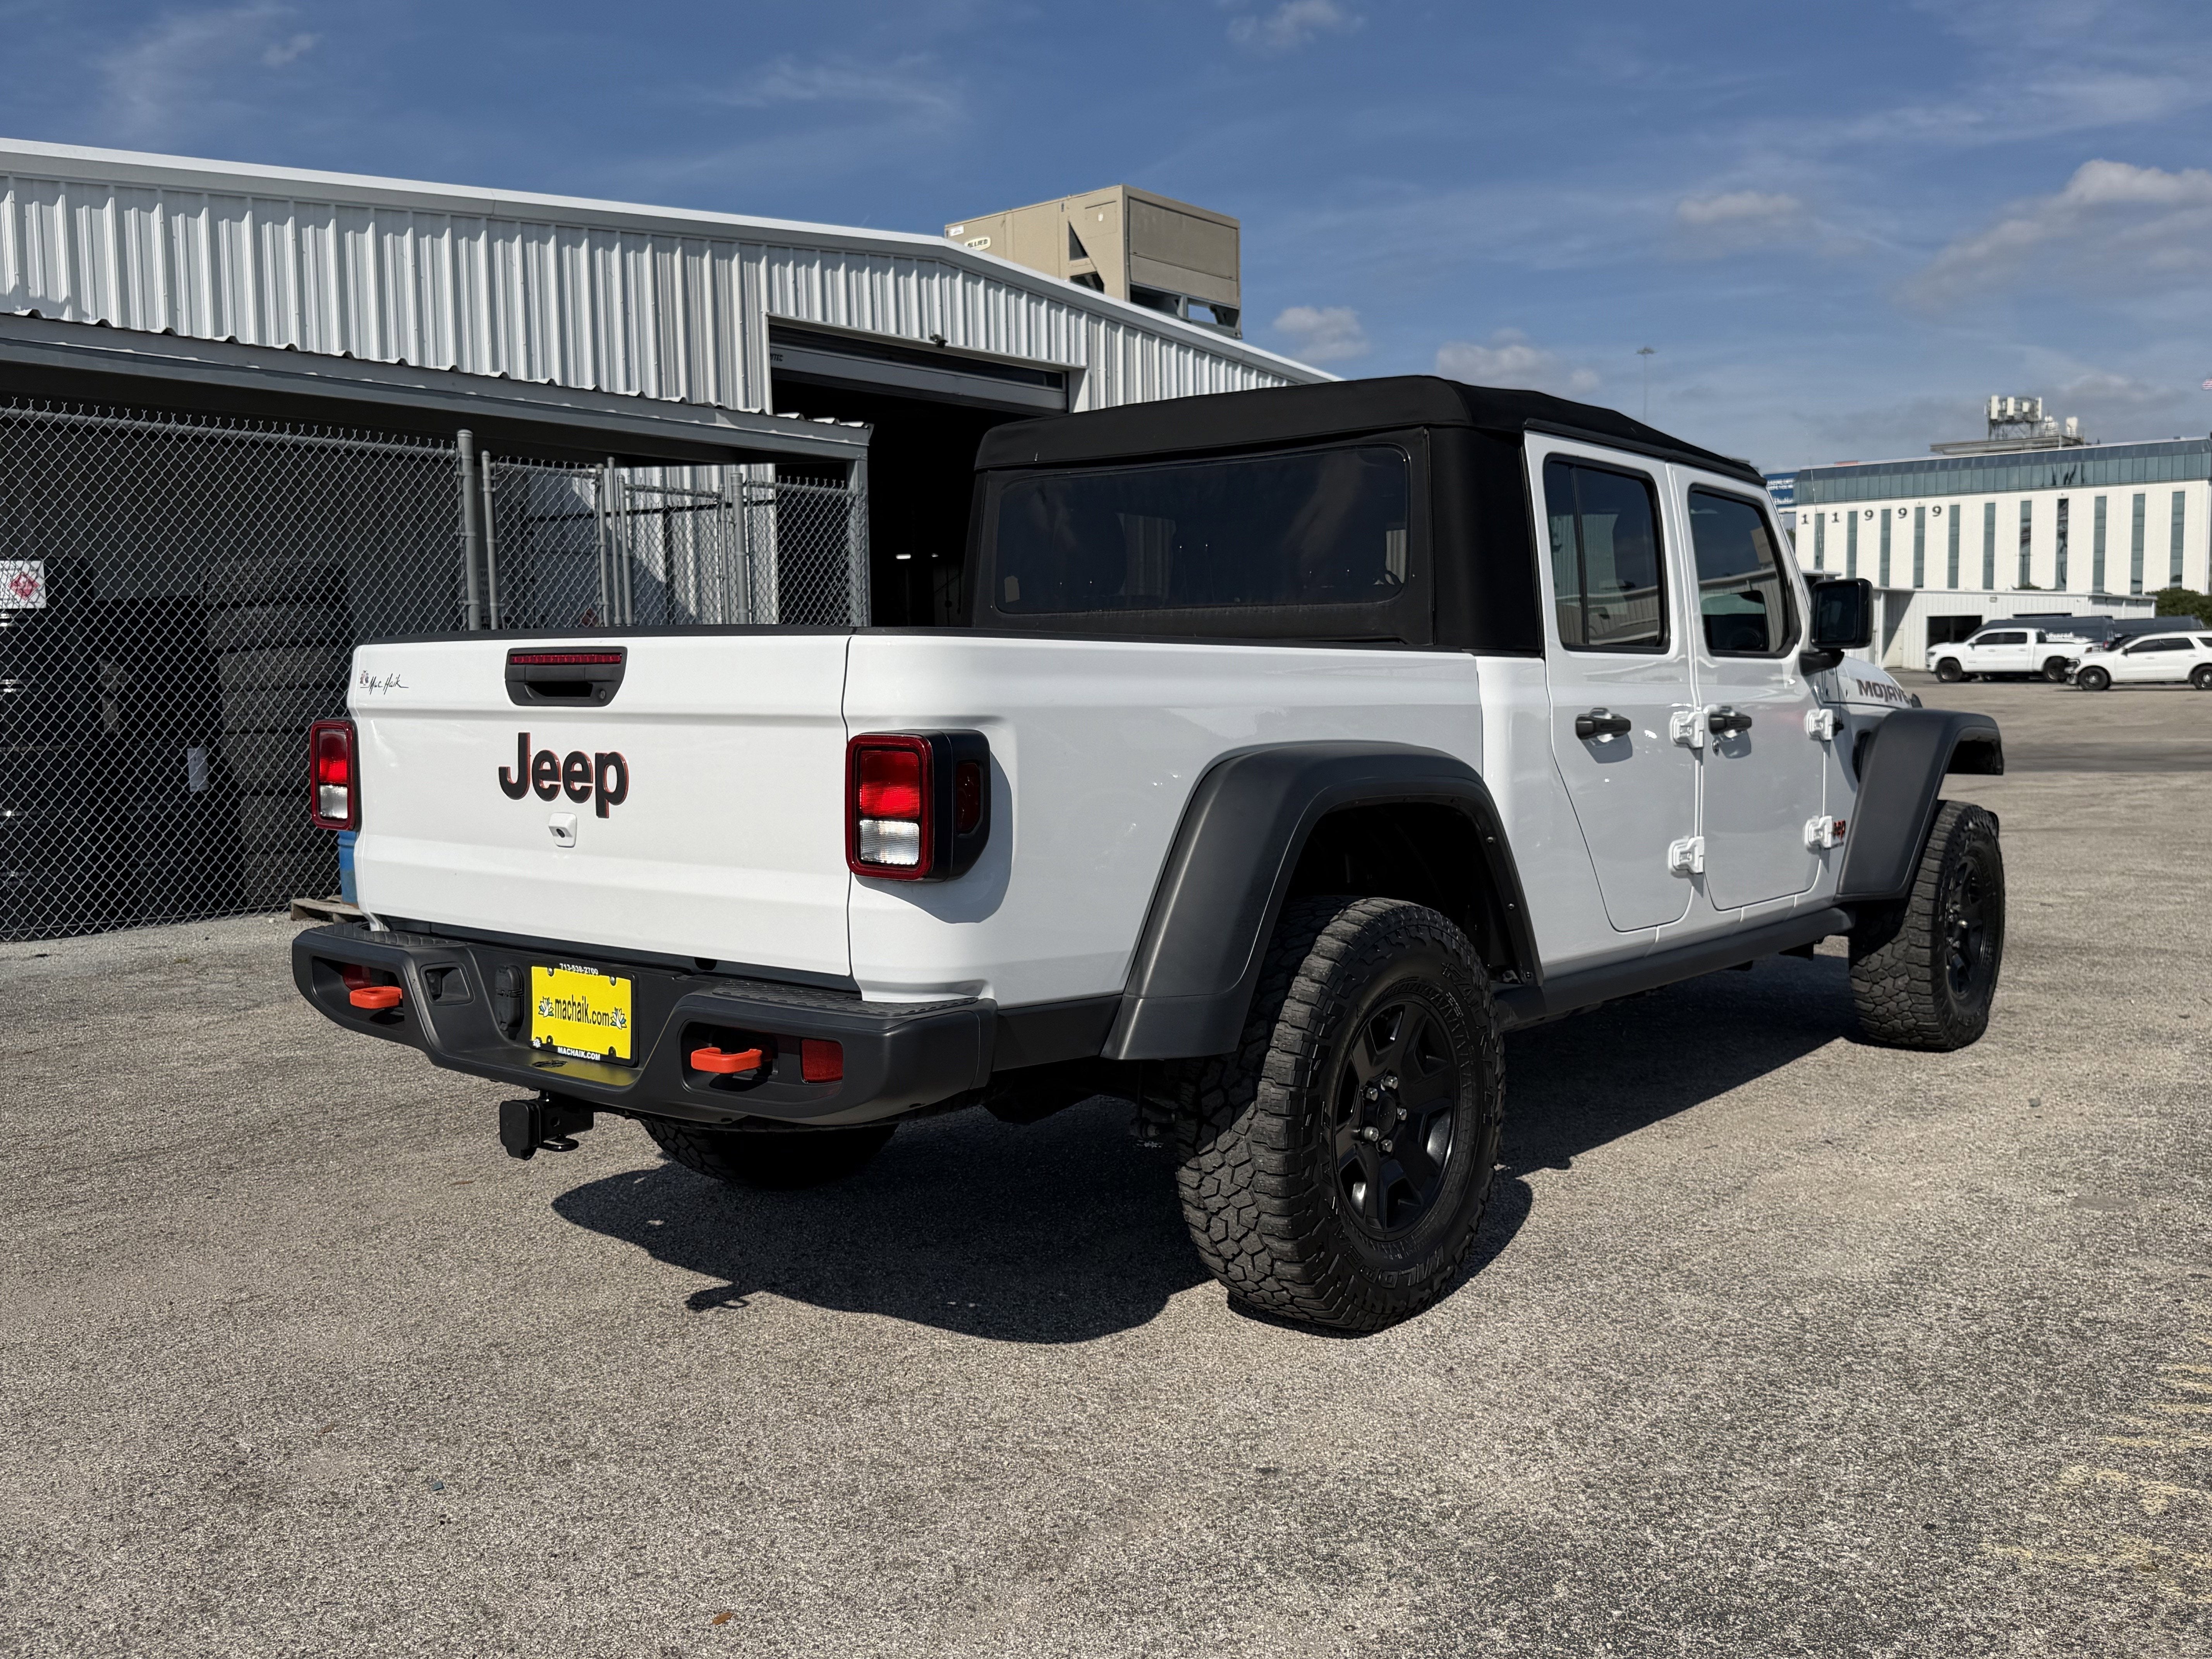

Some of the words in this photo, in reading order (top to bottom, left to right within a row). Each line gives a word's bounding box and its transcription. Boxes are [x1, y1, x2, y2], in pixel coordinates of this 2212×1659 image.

[968, 239, 988, 248] ALLIED
[383, 673, 409, 695] Haik
[498, 732, 629, 819] Jeep
[559, 963, 599, 975] 713-538-2700
[555, 994, 609, 1027] machaik.com
[558, 1046, 601, 1061] MACHAIK.COM
